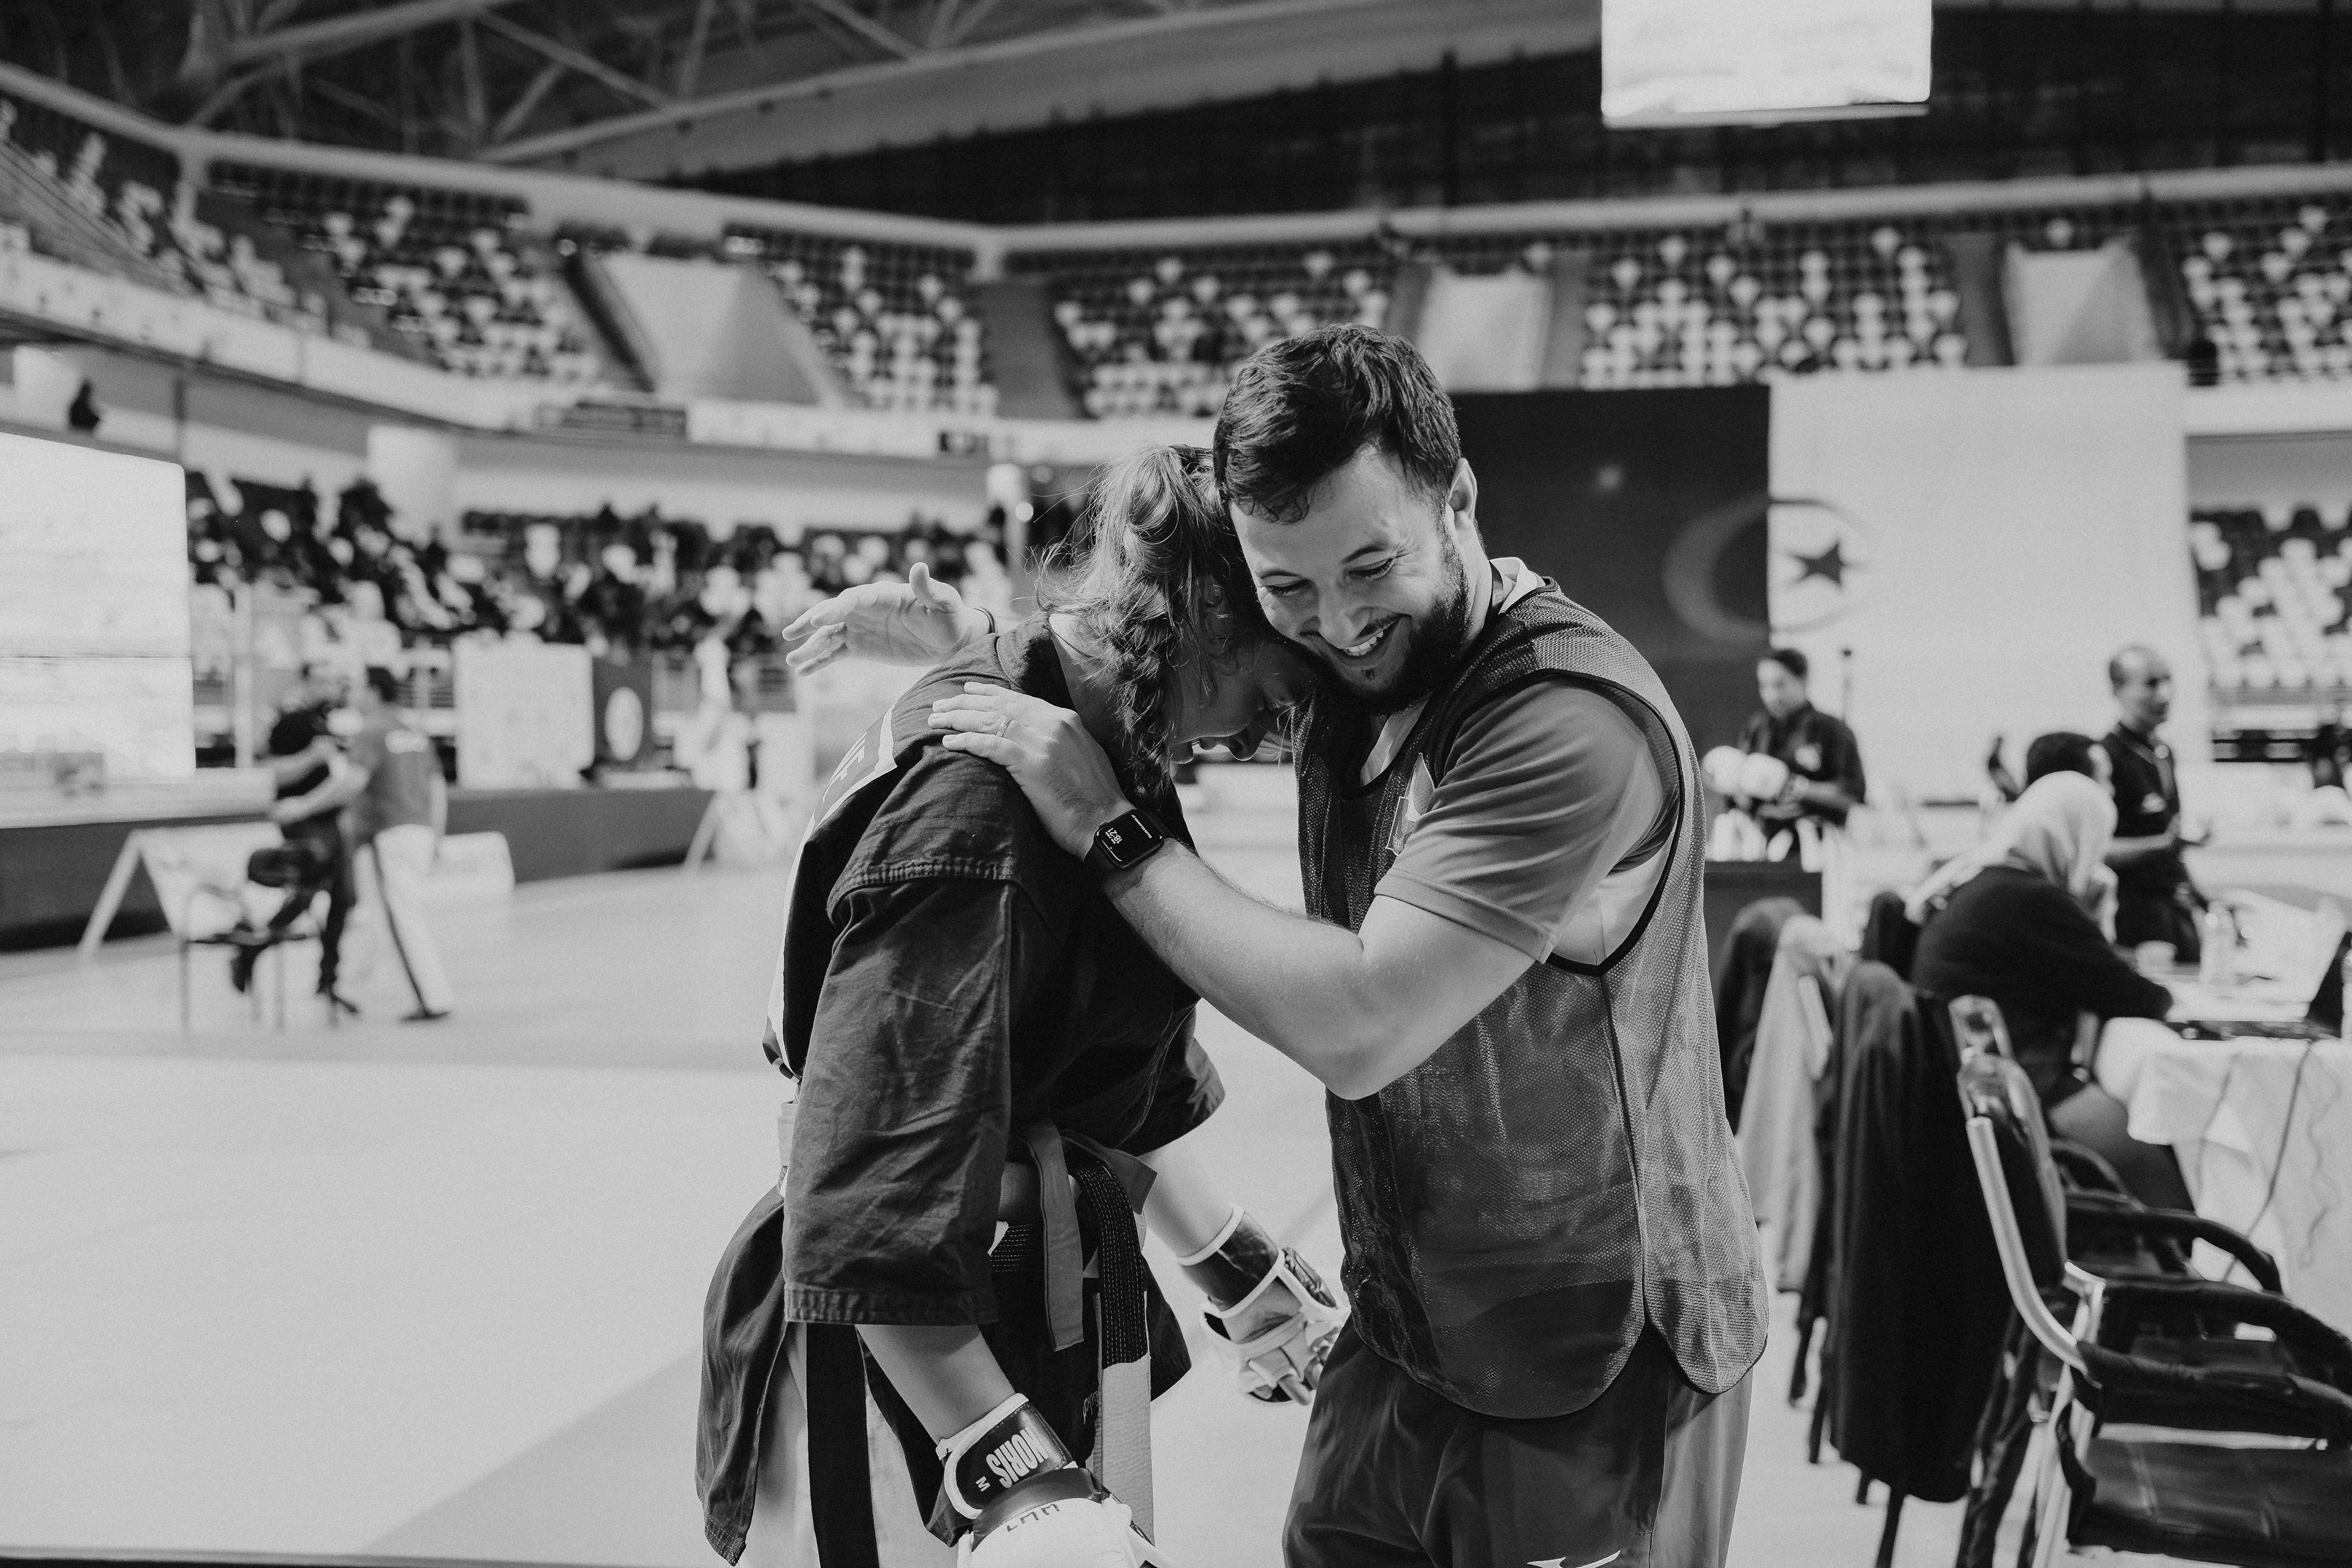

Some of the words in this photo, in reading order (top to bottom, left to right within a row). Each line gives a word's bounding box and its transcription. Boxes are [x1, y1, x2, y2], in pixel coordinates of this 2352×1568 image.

[1107, 827, 1123, 844] 18:21
[986, 1428, 1049, 1488] NORIS
[976, 1476, 990, 1492] M
